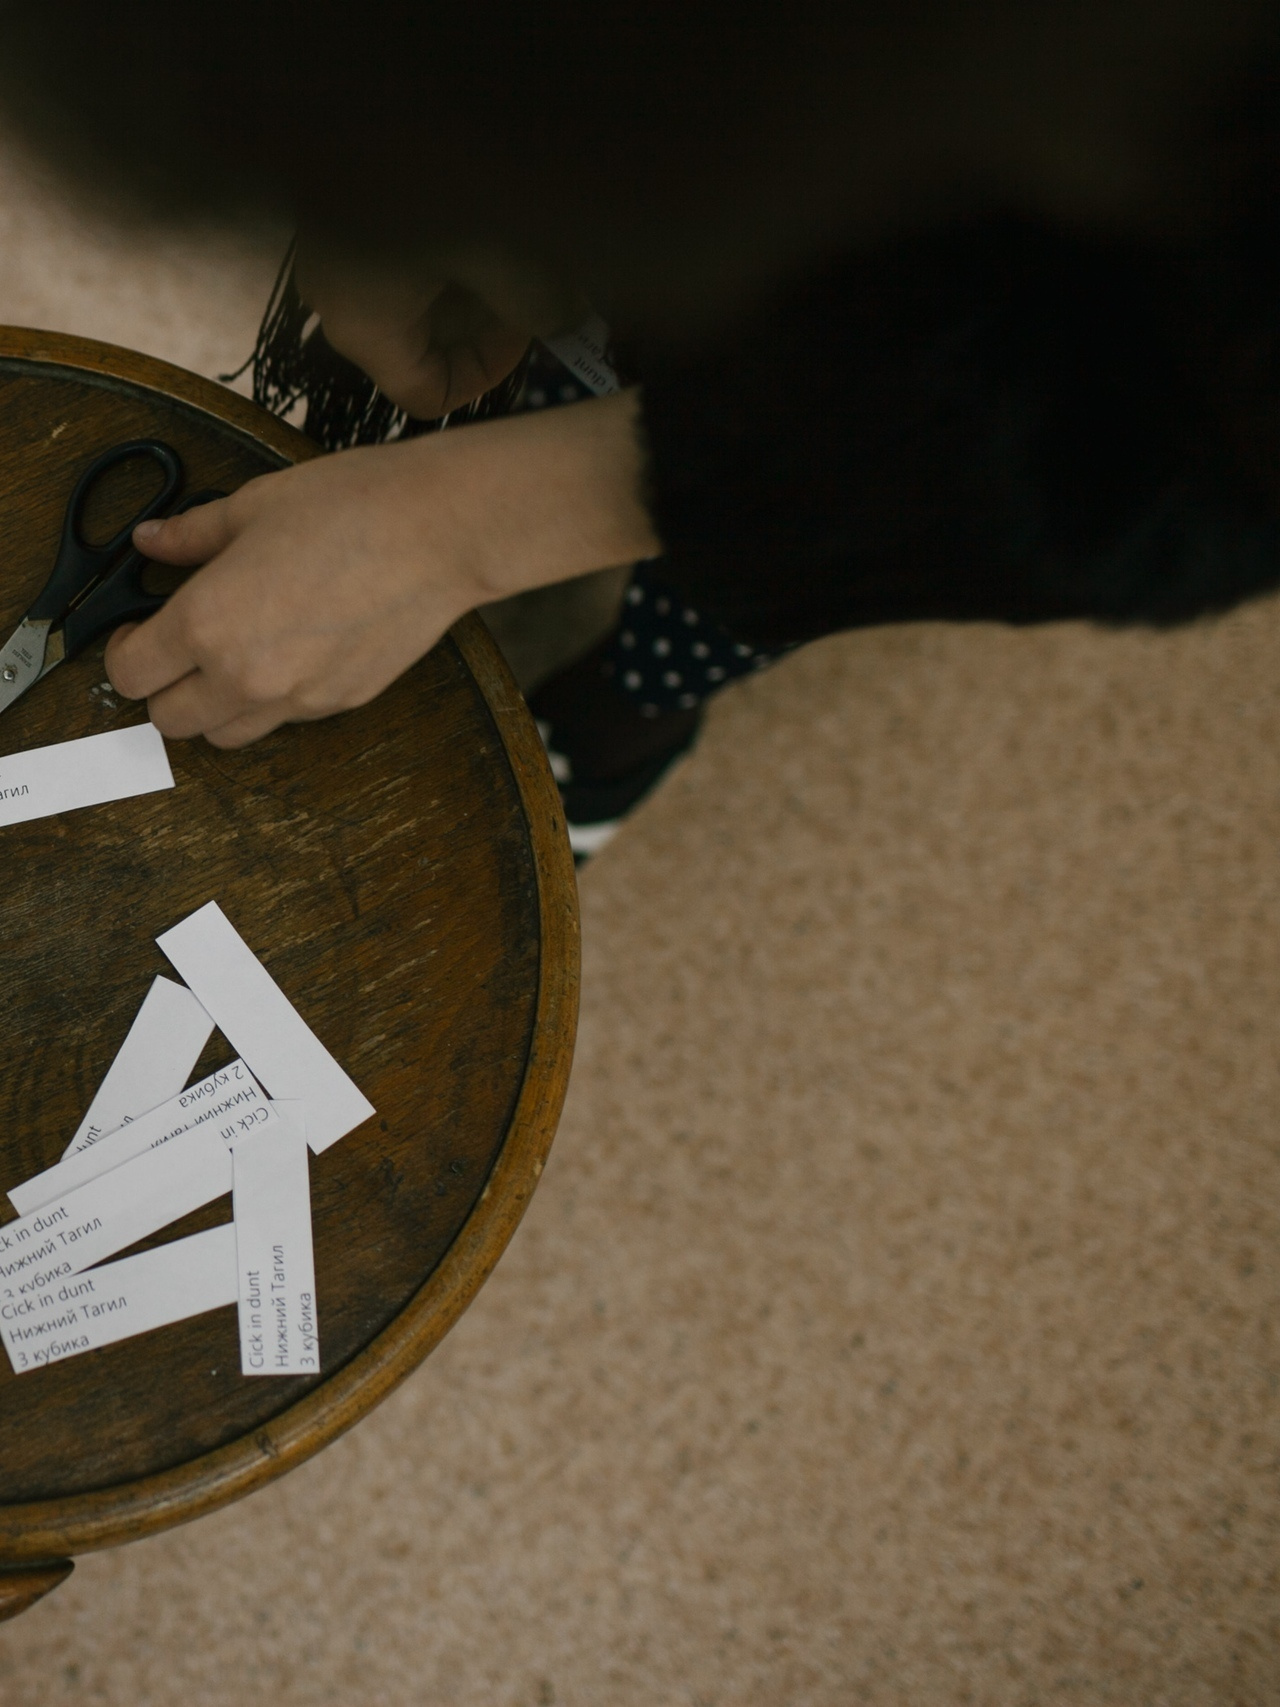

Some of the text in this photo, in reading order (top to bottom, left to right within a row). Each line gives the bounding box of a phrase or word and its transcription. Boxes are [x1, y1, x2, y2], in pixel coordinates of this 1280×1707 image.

[178, 1065, 245, 1108] 2 кубика
[220, 1107, 270, 1140] Cick in
[13, 1228, 31, 1242] in
[33, 1206, 69, 1233] dunt
[57, 1217, 103, 1246] Тагил
[18, 1261, 72, 1296] кубика
[1, 1279, 96, 1320] Cick in dunt
[8, 1296, 128, 1343] Нижний Тагил
[246, 1270, 264, 1369] Cick in dunt
[271, 1245, 289, 1367] Нижний Тагил
[298, 1292, 319, 1366] 3 кубика
[18, 1335, 90, 1367] 3 кубика
